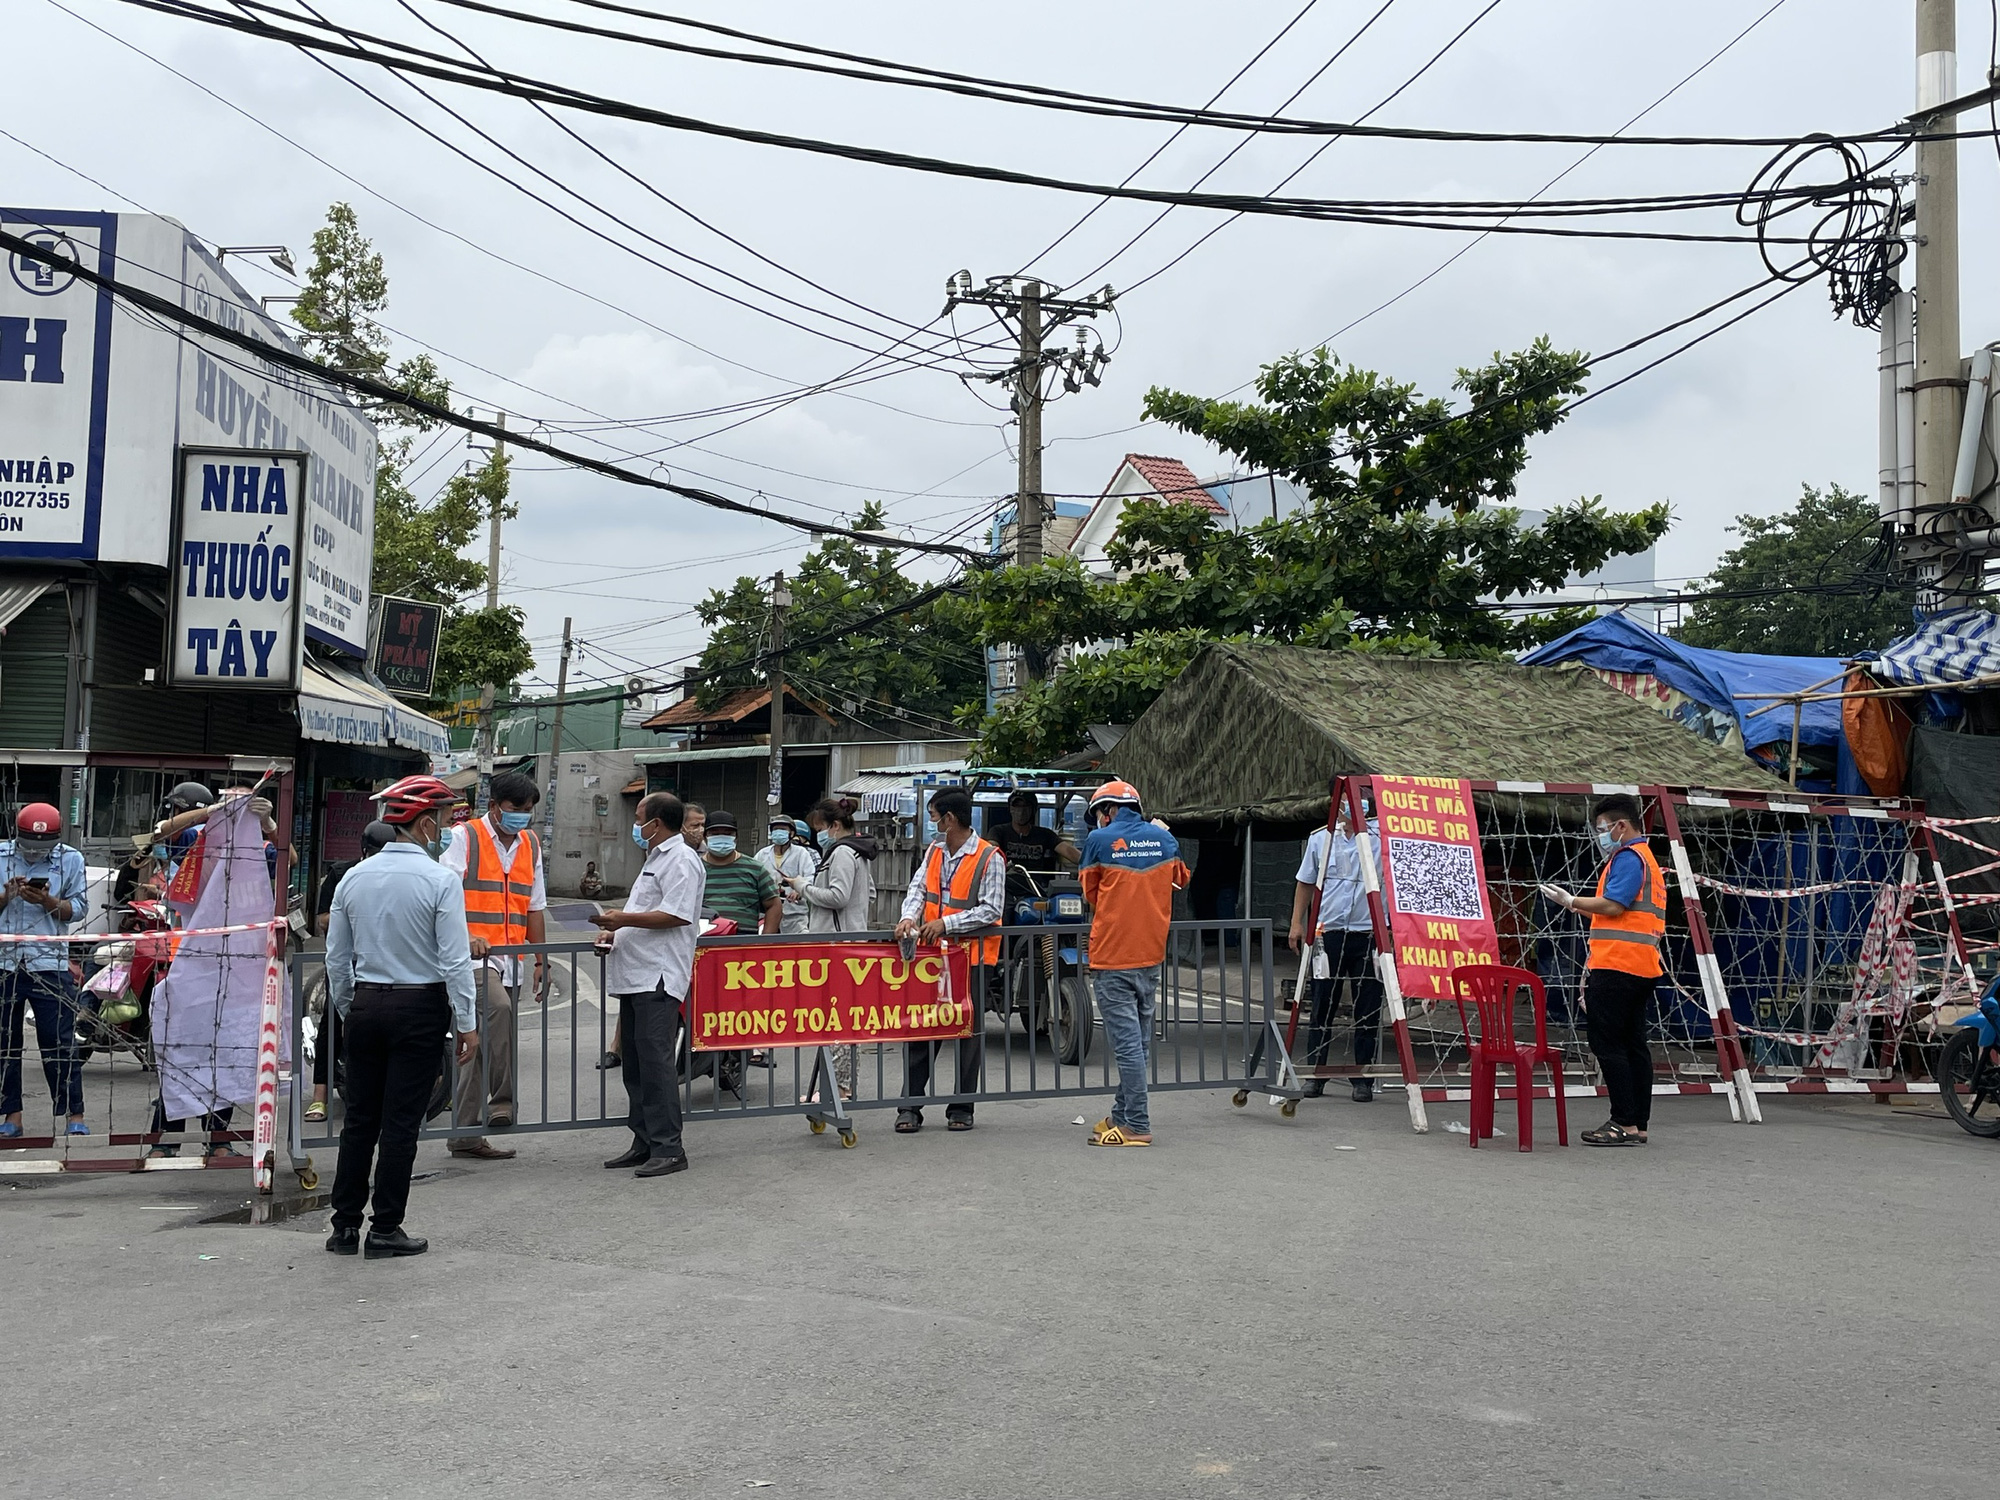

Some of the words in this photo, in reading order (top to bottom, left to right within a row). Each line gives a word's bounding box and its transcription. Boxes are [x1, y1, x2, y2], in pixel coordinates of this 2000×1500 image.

[196, 348, 289, 451] HUYỀN
[0, 489, 71, 510] 027355
[201, 457, 289, 515] NHÀ
[313, 523, 336, 554] GPP
[182, 524, 291, 603] THUỐC
[398, 607, 424, 637] MỸ
[187, 618, 278, 678] TÂY
[382, 636, 429, 669] PHẨM
[1381, 789, 1429, 812] QUÉT
[1434, 795, 1468, 816] MÃ
[1386, 815, 1439, 837] CODE
[1443, 821, 1470, 841] QR
[1129, 839, 1161, 848] AhaMove
[1427, 921, 1460, 941] KHI
[1402, 945, 1448, 968] KHAI
[1452, 948, 1492, 968] BÁO
[724, 958, 831, 990] KHU
[1429, 975, 1440, 994] Y
[702, 1009, 788, 1037] PHONG
[793, 996, 843, 1033] TOẢ
[849, 1004, 902, 1035] TẠM
